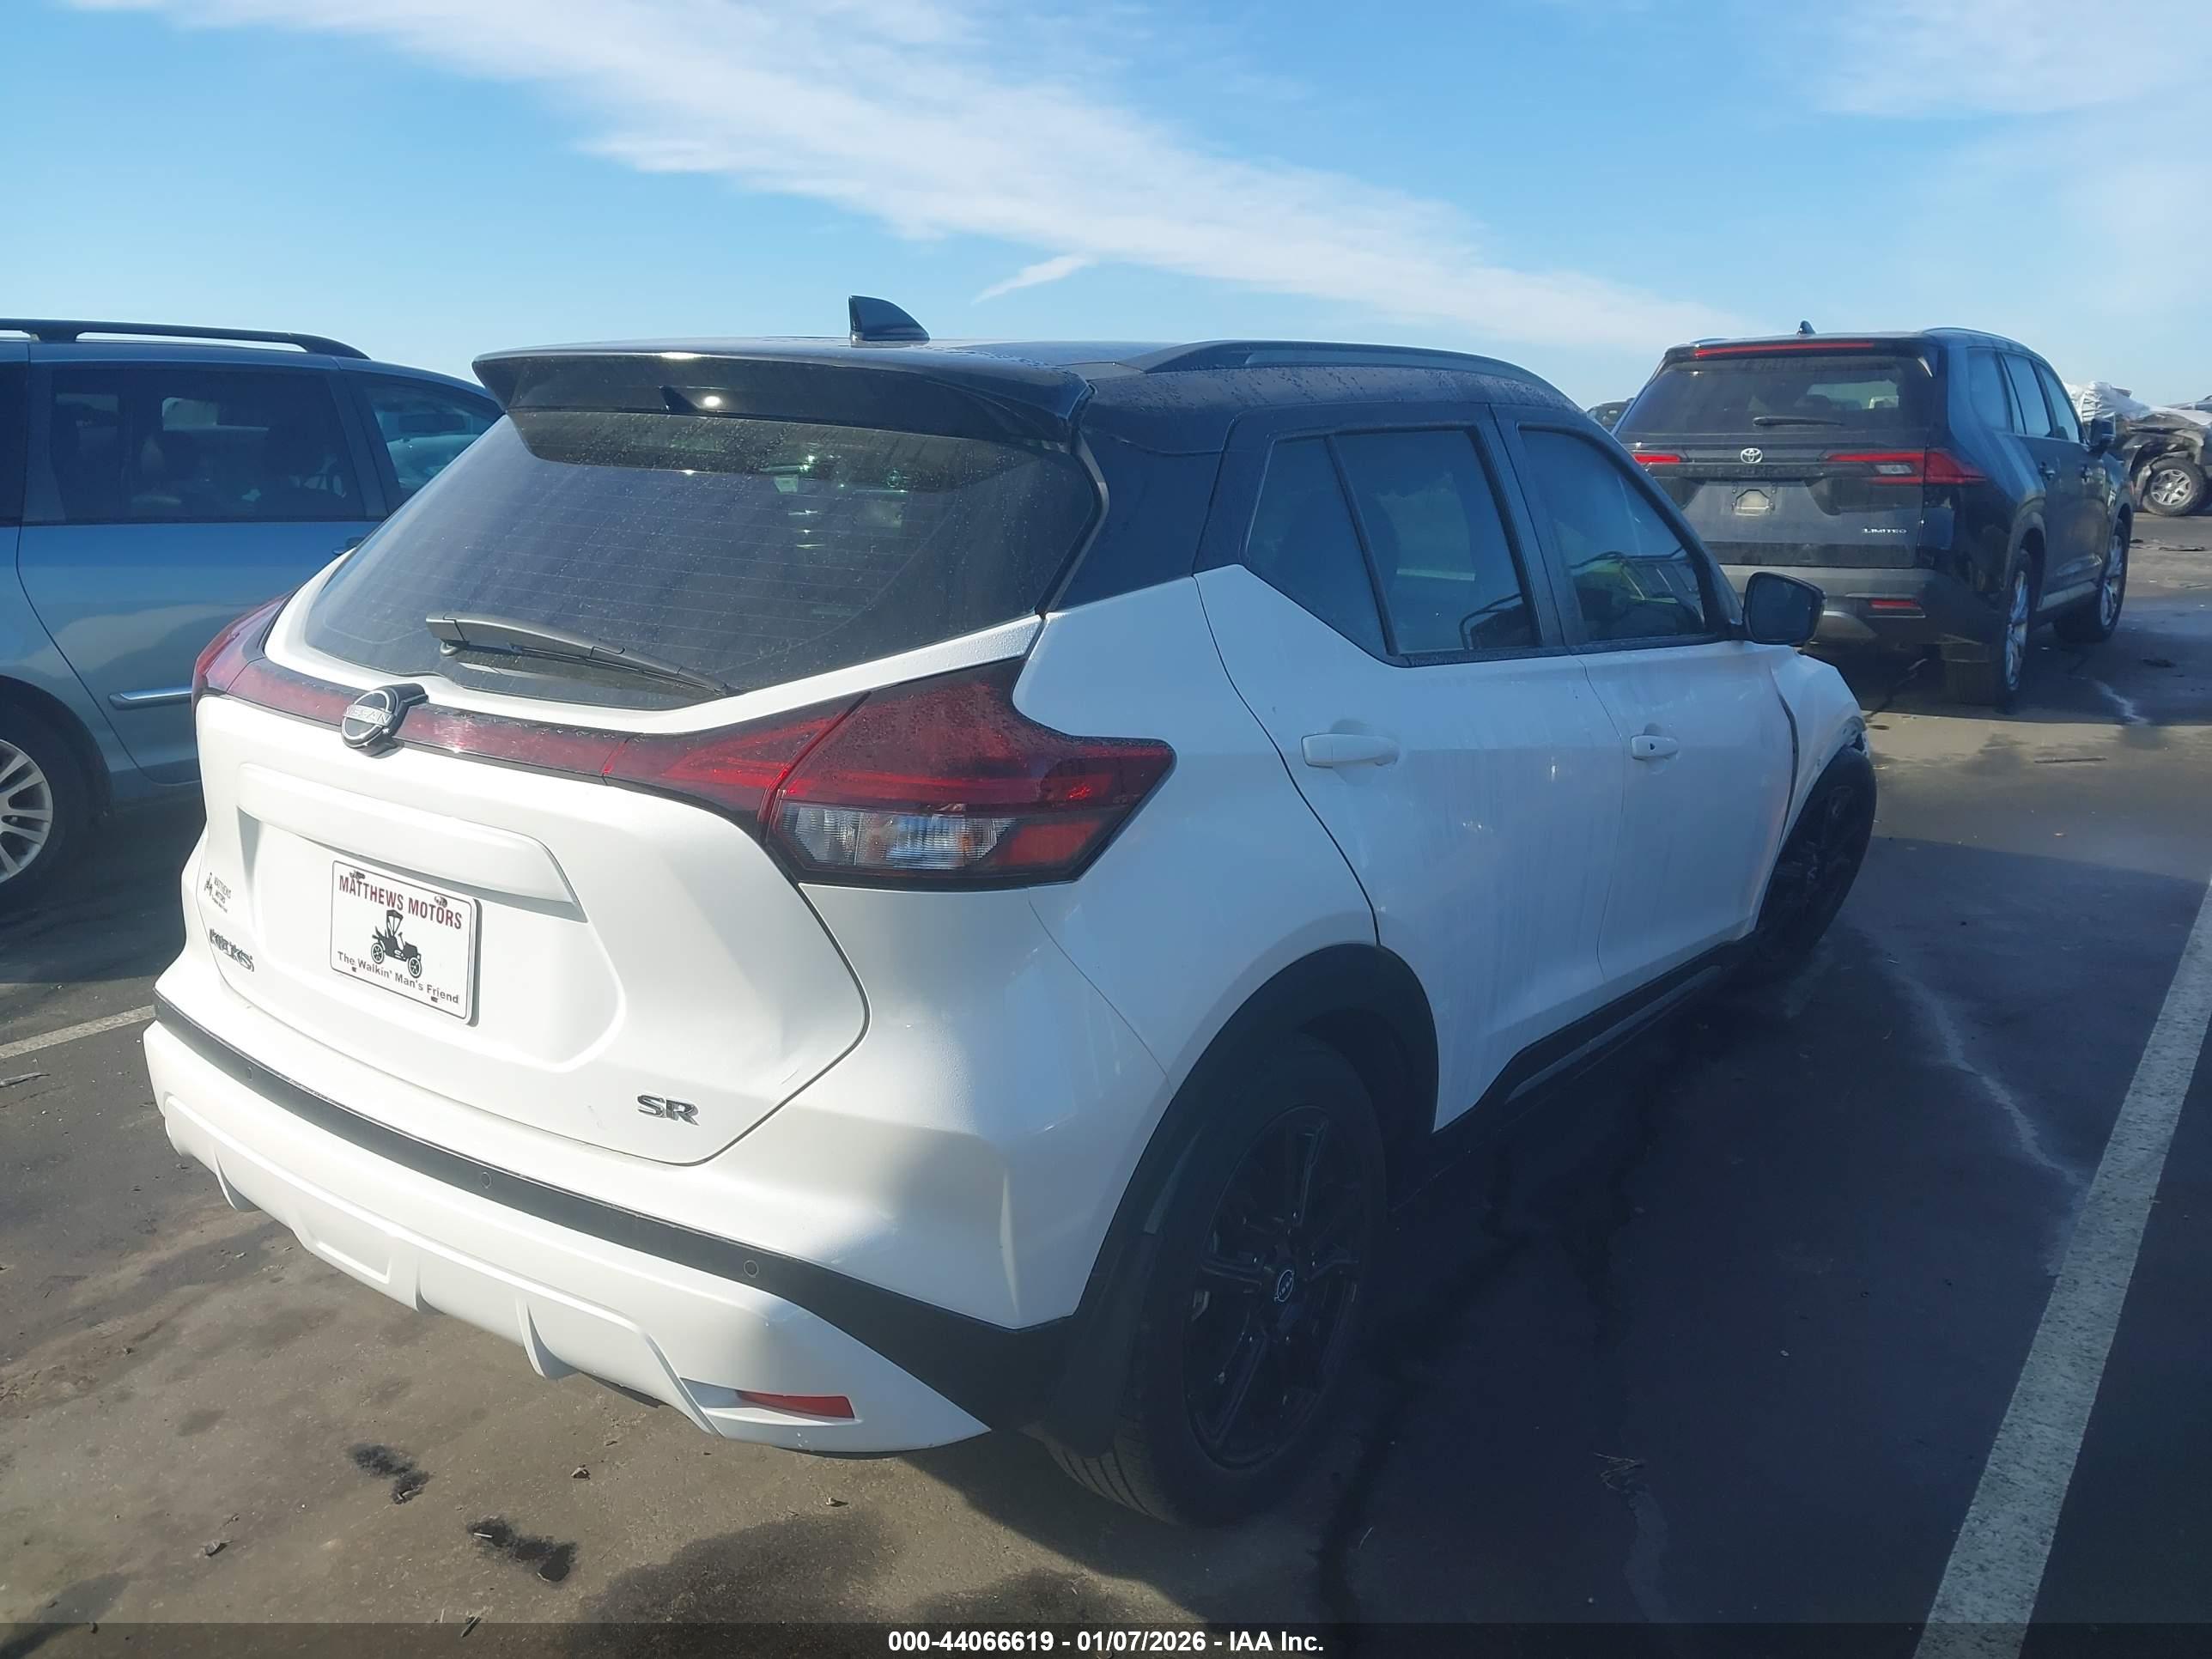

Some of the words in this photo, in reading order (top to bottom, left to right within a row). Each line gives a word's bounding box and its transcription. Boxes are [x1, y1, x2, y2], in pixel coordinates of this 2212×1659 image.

[338, 874, 404, 911] MATTHEWS
[408, 897, 463, 930] MOTORS
[337, 951, 356, 965] The
[358, 957, 392, 979] Walkin'
[394, 972, 424, 991] Man's
[427, 984, 459, 1004] Friend
[637, 1095, 701, 1127] SR
